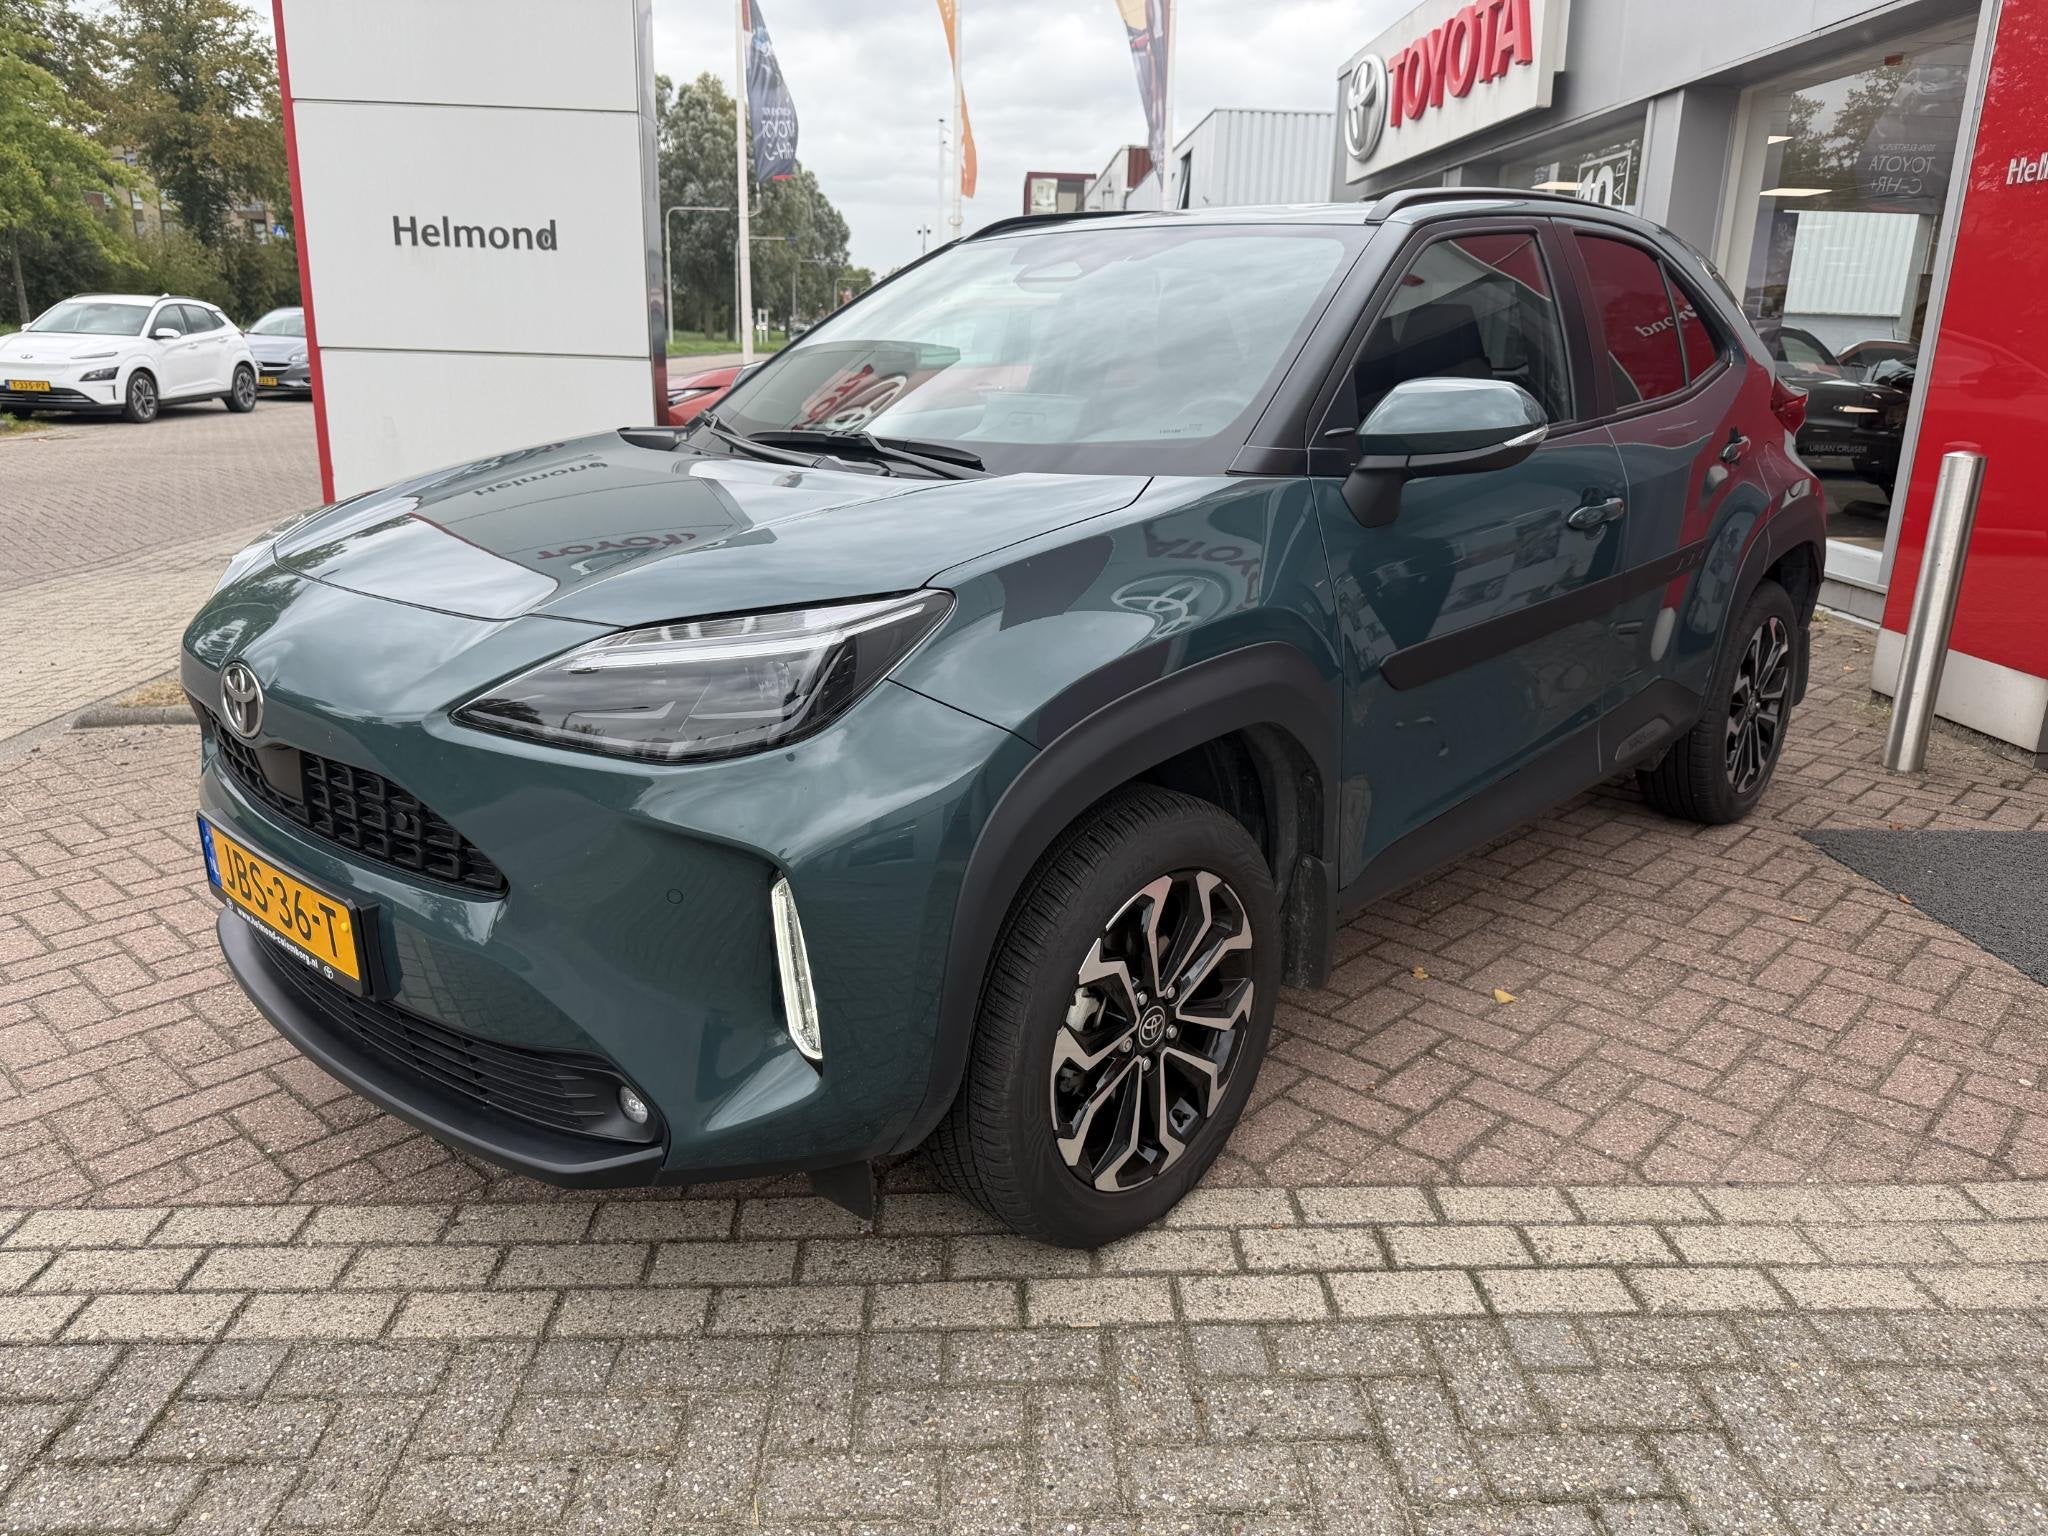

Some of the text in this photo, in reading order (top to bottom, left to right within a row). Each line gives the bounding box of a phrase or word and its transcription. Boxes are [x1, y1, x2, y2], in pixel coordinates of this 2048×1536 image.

[1388, 0, 1533, 128] TOYOTA
[2006, 152, 2048, 186] Hel
[393, 215, 558, 251] Helmond
[224, 843, 338, 959] JBS-36-T
